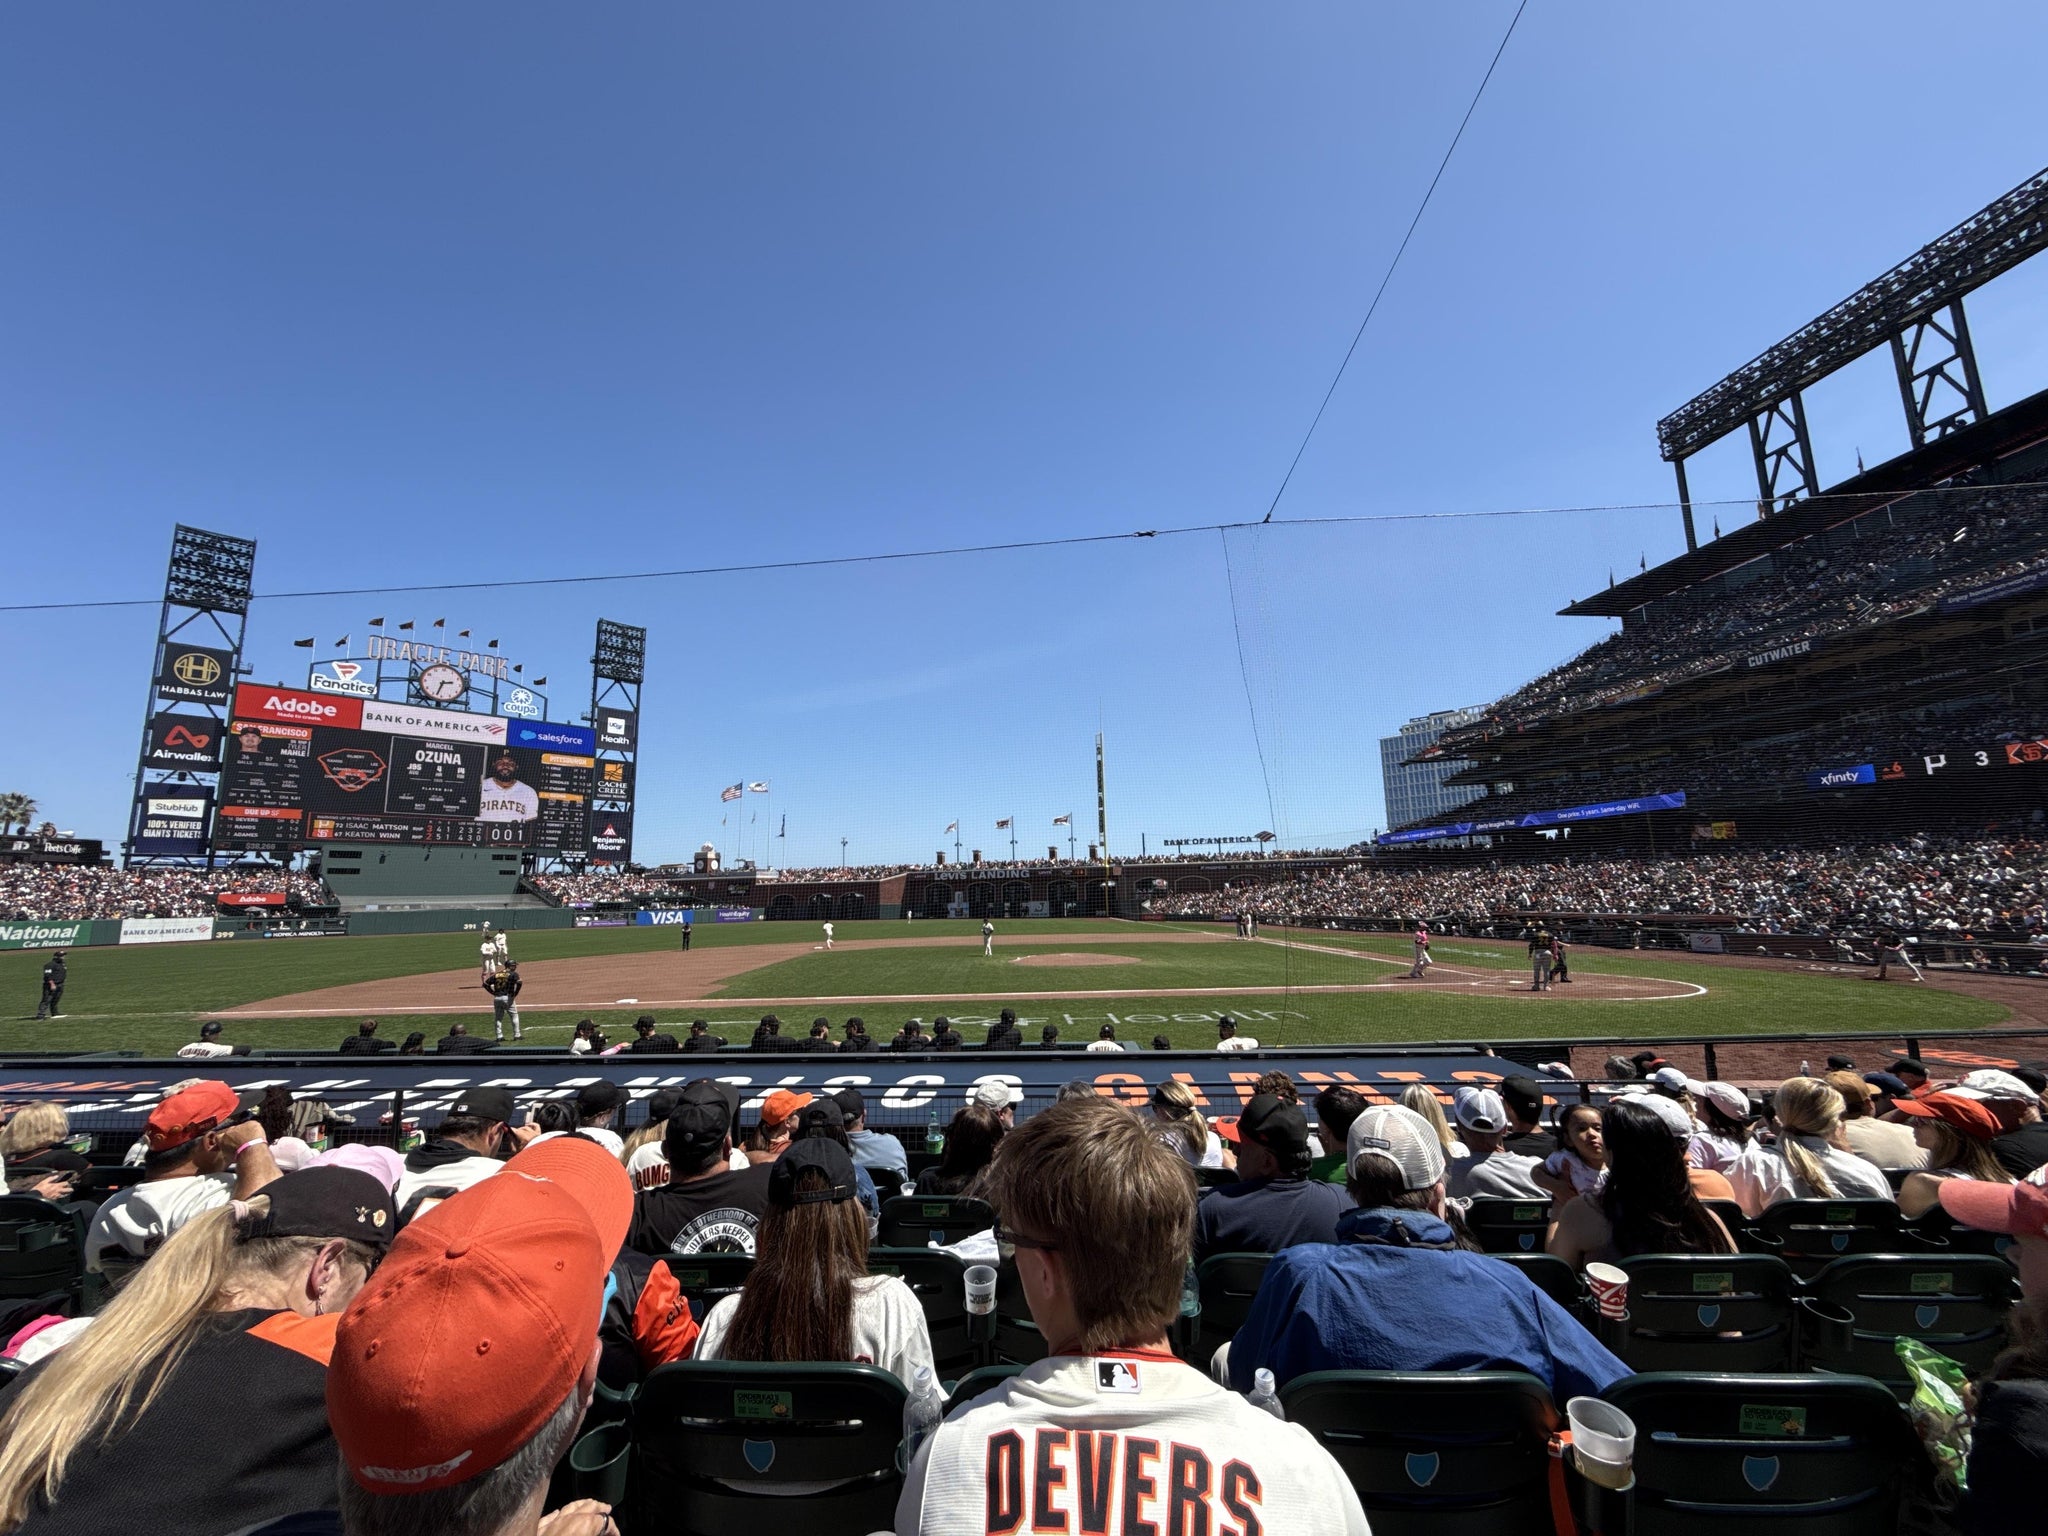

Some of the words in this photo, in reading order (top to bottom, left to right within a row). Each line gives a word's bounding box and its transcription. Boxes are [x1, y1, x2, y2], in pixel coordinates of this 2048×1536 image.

[368, 635, 451, 666] ORACLE
[457, 651, 510, 680] PARK
[1748, 640, 1811, 667] CUTWATER
[314, 675, 376, 694] Fanatics
[161, 685, 203, 697] HABBAS
[204, 690, 226, 698] LAW
[263, 696, 337, 717] Adobe
[505, 704, 536, 715] coupa
[366, 712, 402, 724] BANK
[406, 717, 422, 726] OF
[425, 720, 480, 733] AMERICA
[260, 726, 308, 738] FRANCISCO
[537, 732, 583, 745] salesforce
[600, 734, 629, 745] Health
[426, 742, 454, 750] MARCELL
[280, 749, 306, 757] MAHLE
[415, 750, 462, 765] OZUNA
[1974, 750, 1989, 767] 3
[1892, 762, 1902, 772] 6
[597, 780, 628, 789] CACHE
[1820, 771, 1859, 786] xfinity
[598, 786, 626, 795] CREEK
[155, 803, 199, 812] StubHub
[480, 800, 526, 815] PIRATES
[1600, 806, 1626, 814] Same-day
[147, 820, 168, 829] 100%
[169, 820, 202, 830] VERIFIED
[143, 829, 171, 838] GIANTS
[172, 830, 203, 839] TICKETS
[492, 828, 500, 840] 0
[504, 829, 512, 840] 0
[1207, 836, 1252, 844] AMERICA
[592, 836, 626, 846] Benjamin
[971, 869, 1030, 880] LANDING
[650, 911, 684, 924] VISA
[720, 910, 750, 919] HealthEquity
[0, 924, 80, 940] National
[123, 928, 146, 936] BANK
[148, 928, 158, 936] OF
[22, 940, 40, 948] Car
[42, 939, 73, 947] Rental
[1063, 1010, 1312, 1025] Health
[636, 1163, 670, 1190] BUMG
[686, 1210, 744, 1234] BROTHERHOOD
[745, 1216, 754, 1226] OF
[722, 1224, 750, 1243] KEEPER
[985, 1428, 1263, 1536] DEVERS
